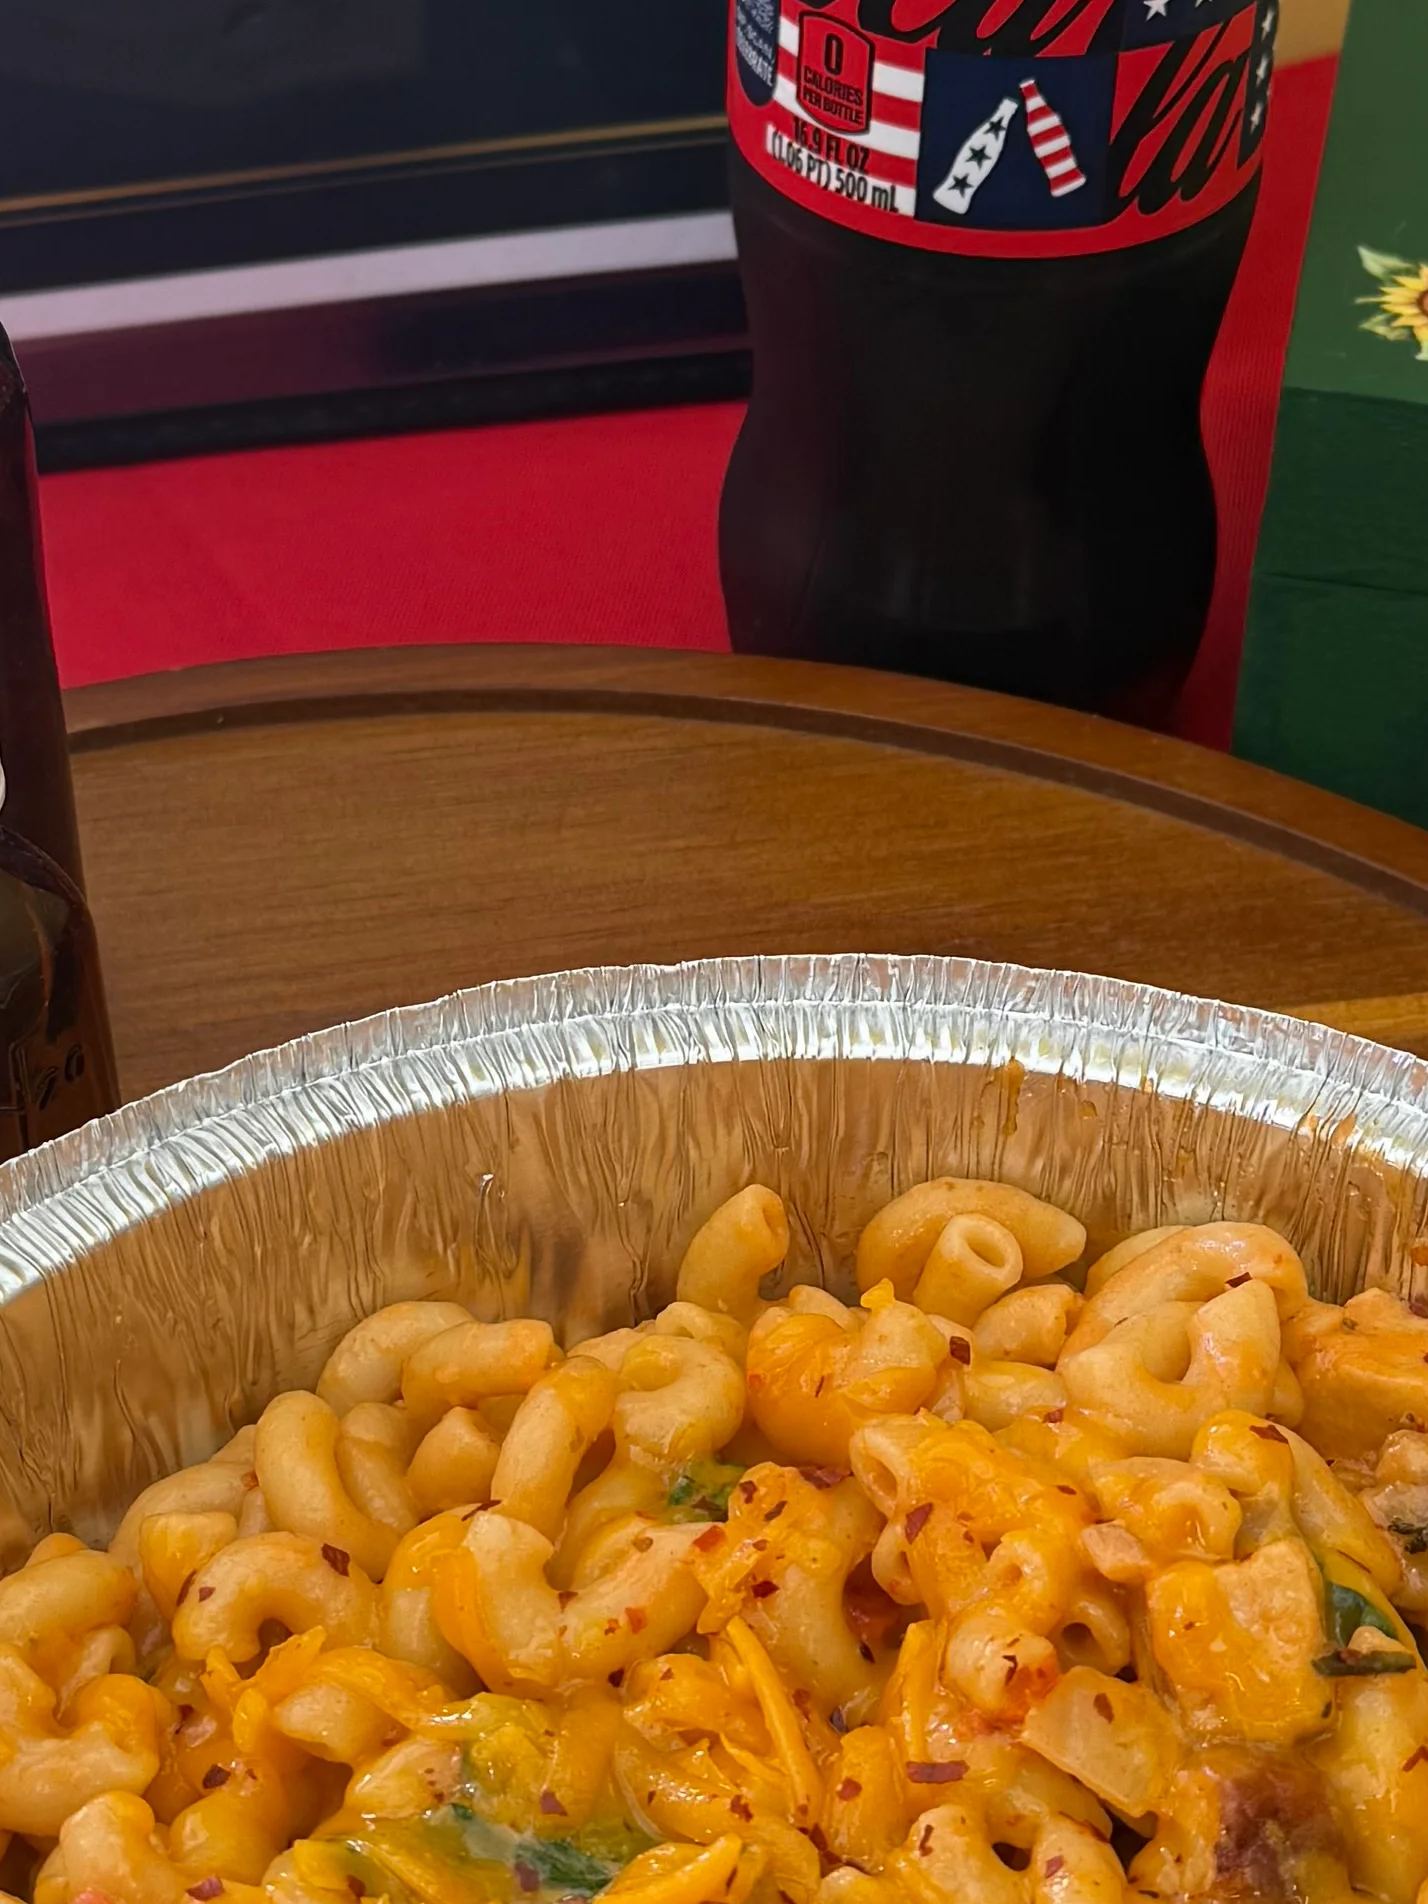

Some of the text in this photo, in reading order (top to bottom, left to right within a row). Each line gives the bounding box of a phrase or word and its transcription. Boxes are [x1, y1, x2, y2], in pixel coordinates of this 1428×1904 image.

[824, 33, 844, 76] 0
[802, 87, 864, 125] PER BOTTLE
[803, 65, 864, 108] CALORIES
[793, 115, 871, 176] 16.9 FL OZ
[771, 129, 900, 215] (1.06 PT) 500 mL
